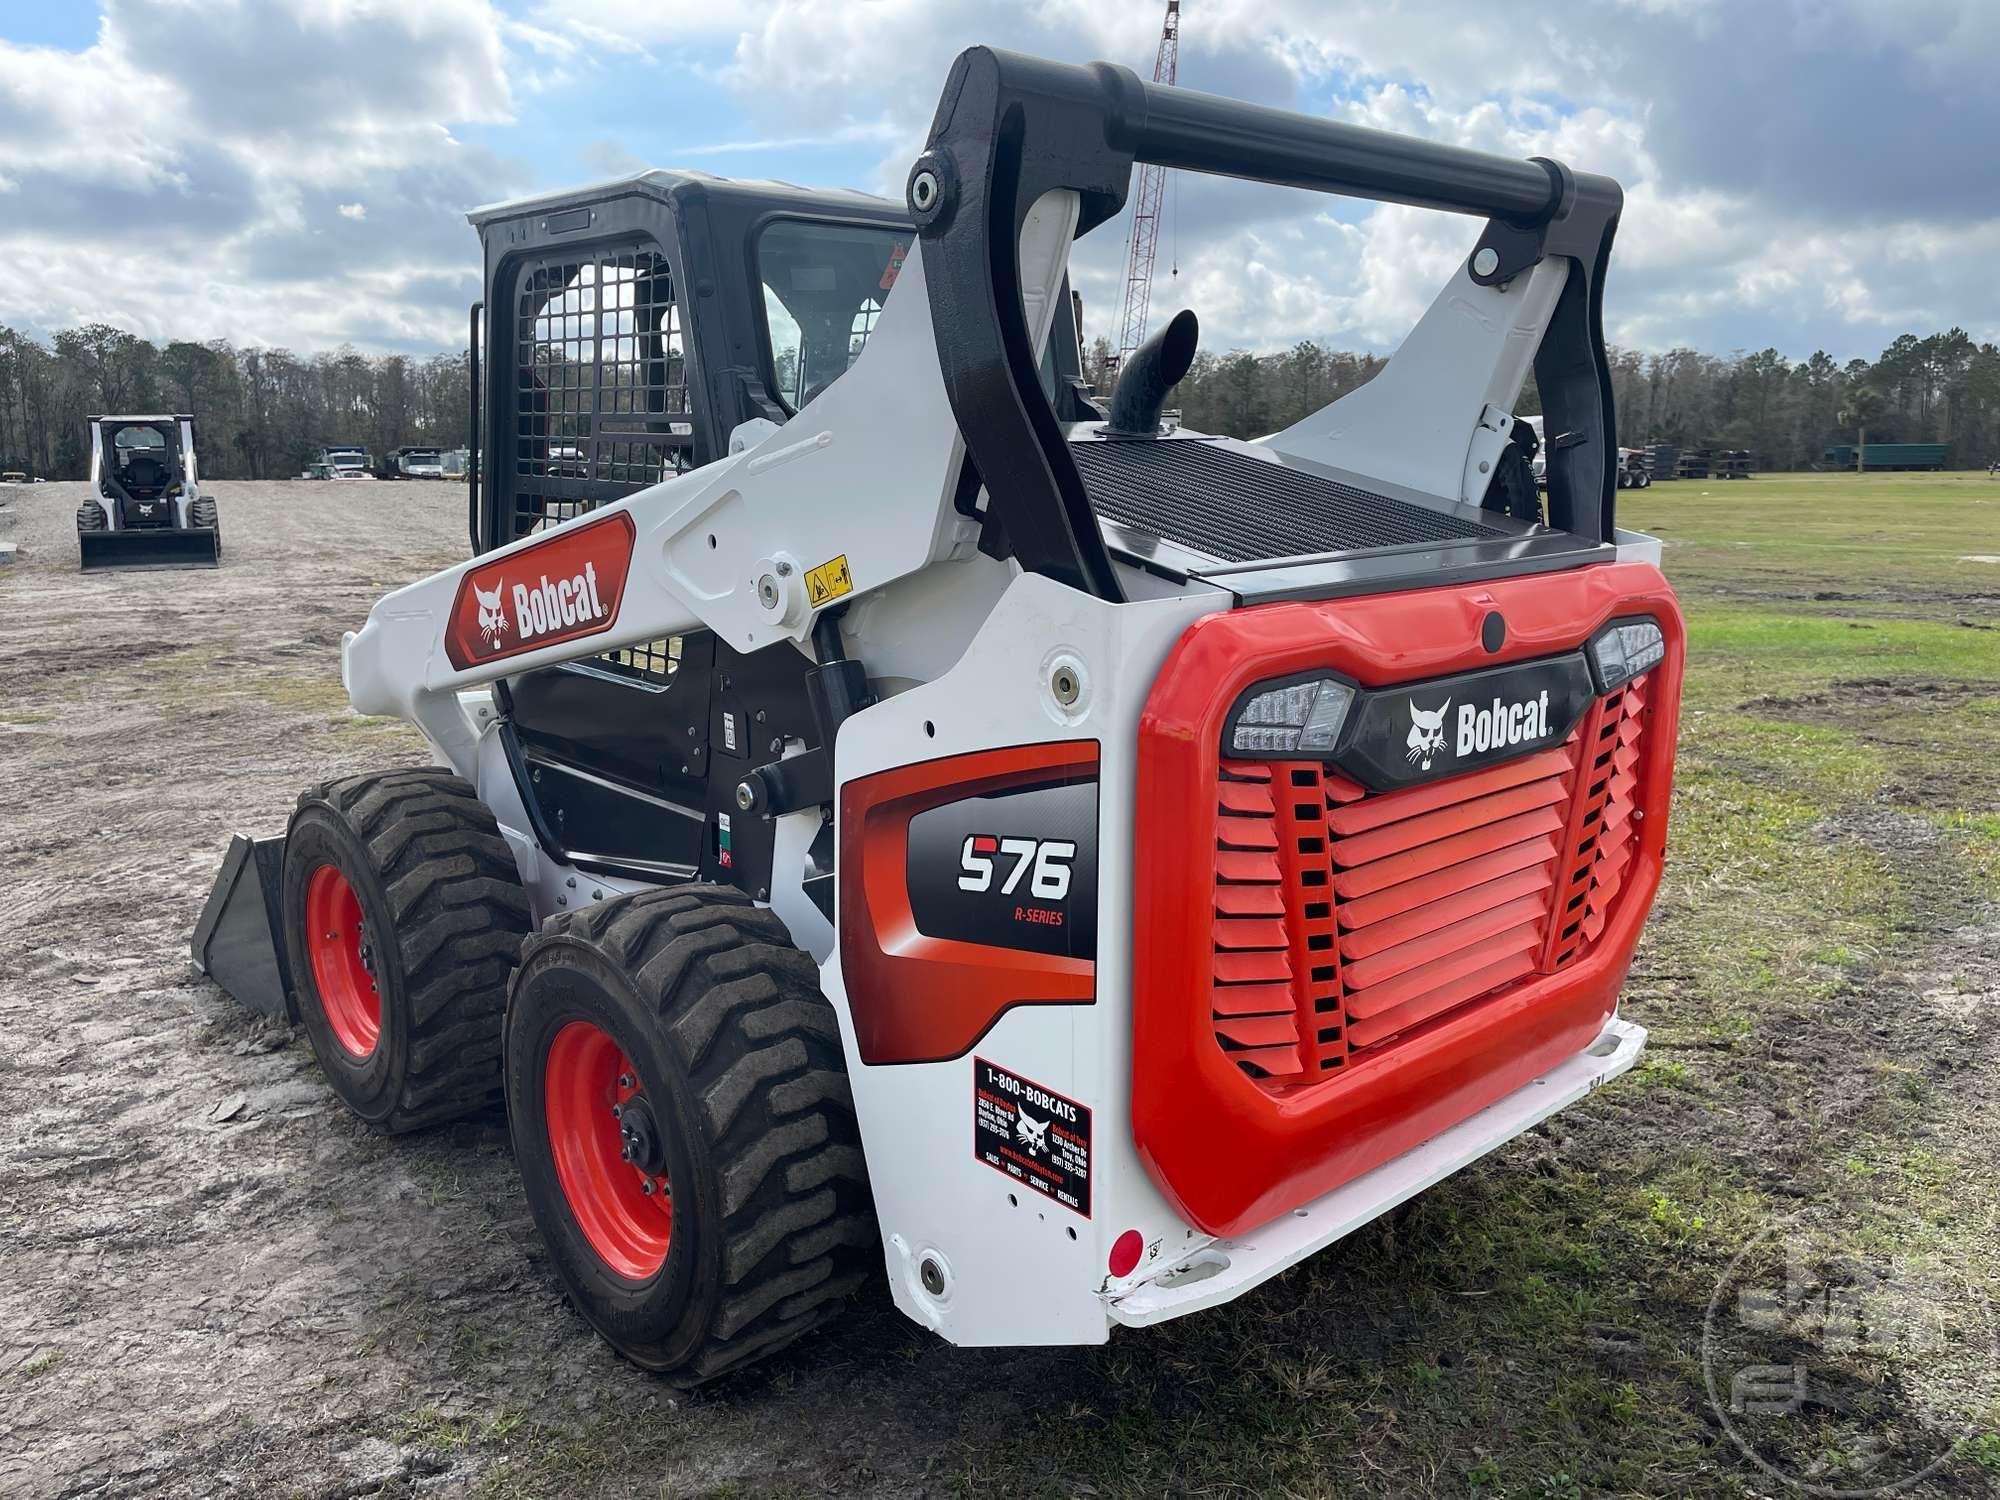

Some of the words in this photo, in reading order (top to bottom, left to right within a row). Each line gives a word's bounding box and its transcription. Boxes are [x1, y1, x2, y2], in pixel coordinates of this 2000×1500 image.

[512, 561, 602, 639] Bobcat
[1456, 690, 1549, 757] Bobcat
[957, 836, 1075, 900] S76
[1015, 907, 1064, 926] R-SERIES
[987, 1068, 1077, 1123] 1-800-BOBCATS
[1075, 1155, 1087, 1168] Ohio
[1080, 1146, 1087, 1158] Dr
[986, 1152, 999, 1166] SALES
[1007, 1163, 1022, 1177] PARTS
[1030, 1175, 1049, 1192] SERVICE
[1057, 1189, 1078, 1208] RENTALS
